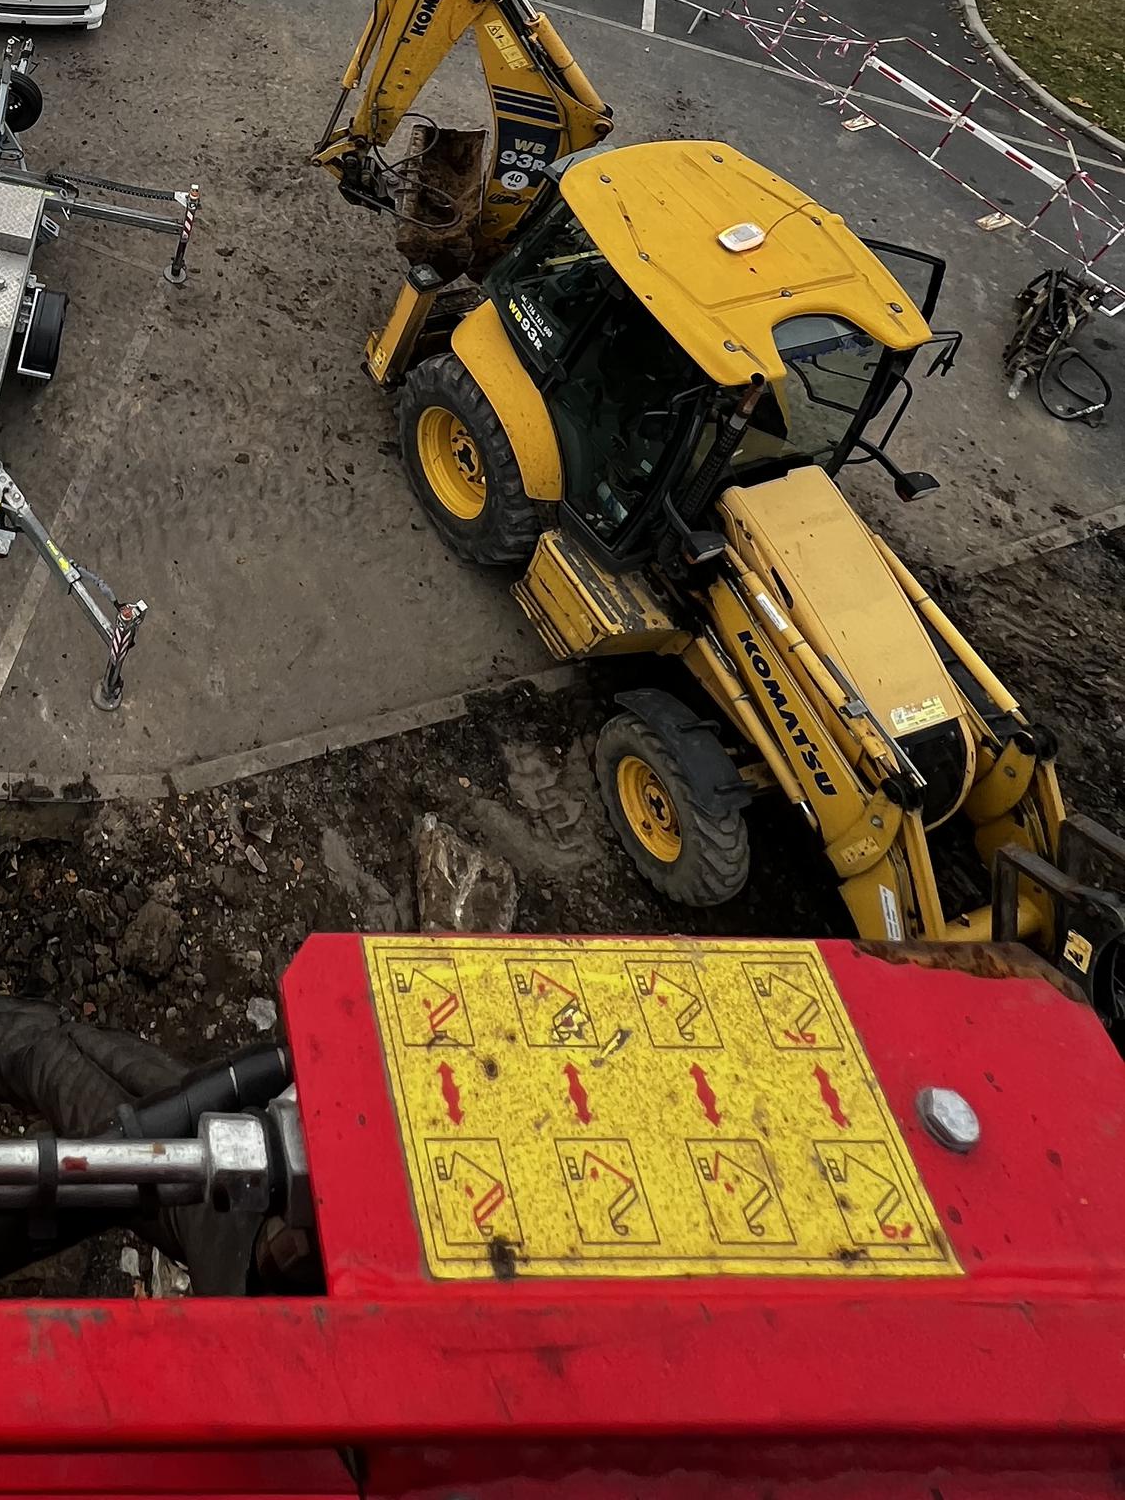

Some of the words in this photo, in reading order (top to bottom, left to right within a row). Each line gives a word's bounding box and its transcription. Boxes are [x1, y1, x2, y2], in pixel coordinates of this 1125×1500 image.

[514, 138, 547, 155] WB
[499, 150, 546, 172] 93R
[507, 173, 523, 183] 40
[736, 630, 838, 796] KOMATSU
